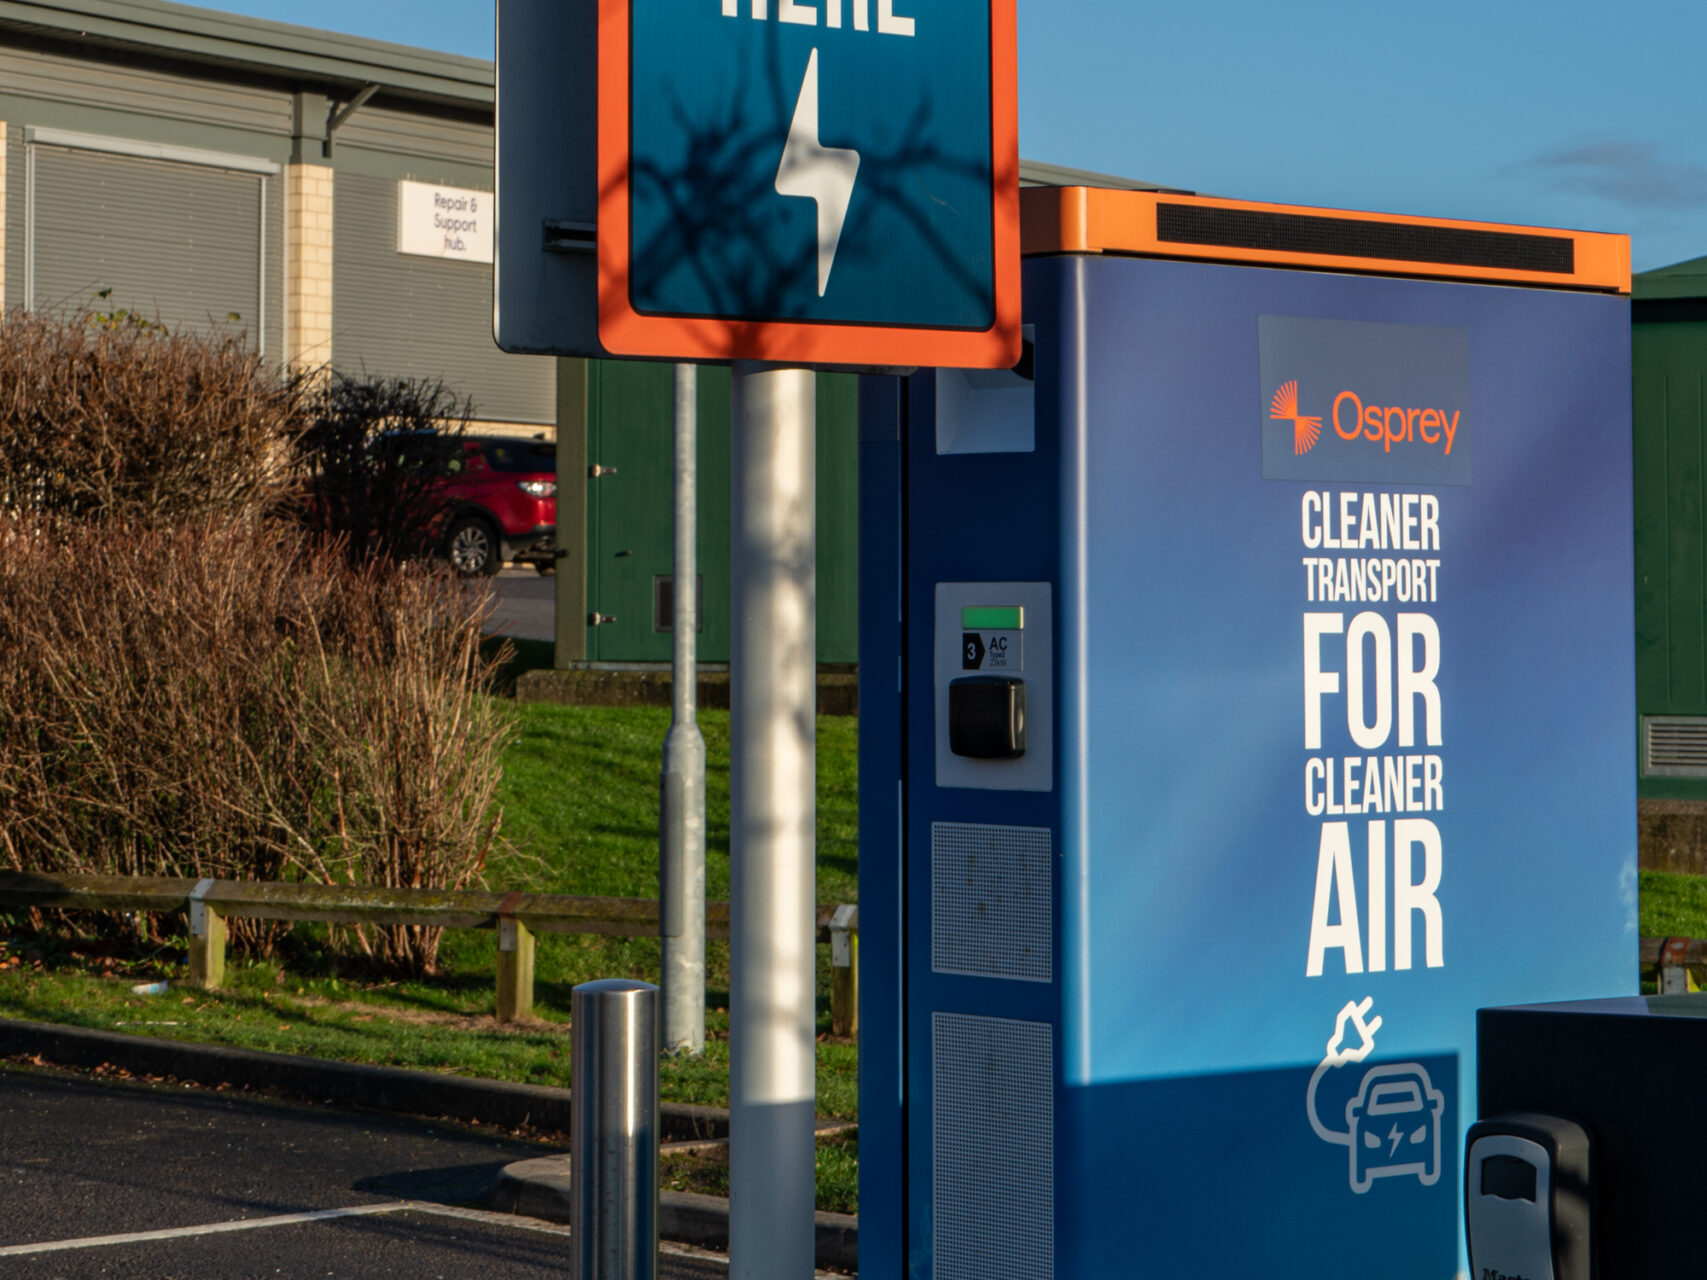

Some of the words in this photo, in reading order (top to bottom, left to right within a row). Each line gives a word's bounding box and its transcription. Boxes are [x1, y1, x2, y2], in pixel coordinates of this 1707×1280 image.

[434, 192, 468, 212] Repair
[434, 212, 477, 233] Support
[444, 234, 467, 252] hub.
[1332, 391, 1460, 455] Osprey
[1302, 490, 1440, 550] CLEANER
[1303, 558, 1440, 602] TRANSPORT
[967, 642, 977, 660] 3
[989, 636, 1008, 651] AC
[1303, 611, 1443, 749] FOR
[1305, 755, 1443, 816] CLEANER
[1306, 818, 1444, 977] AIR
